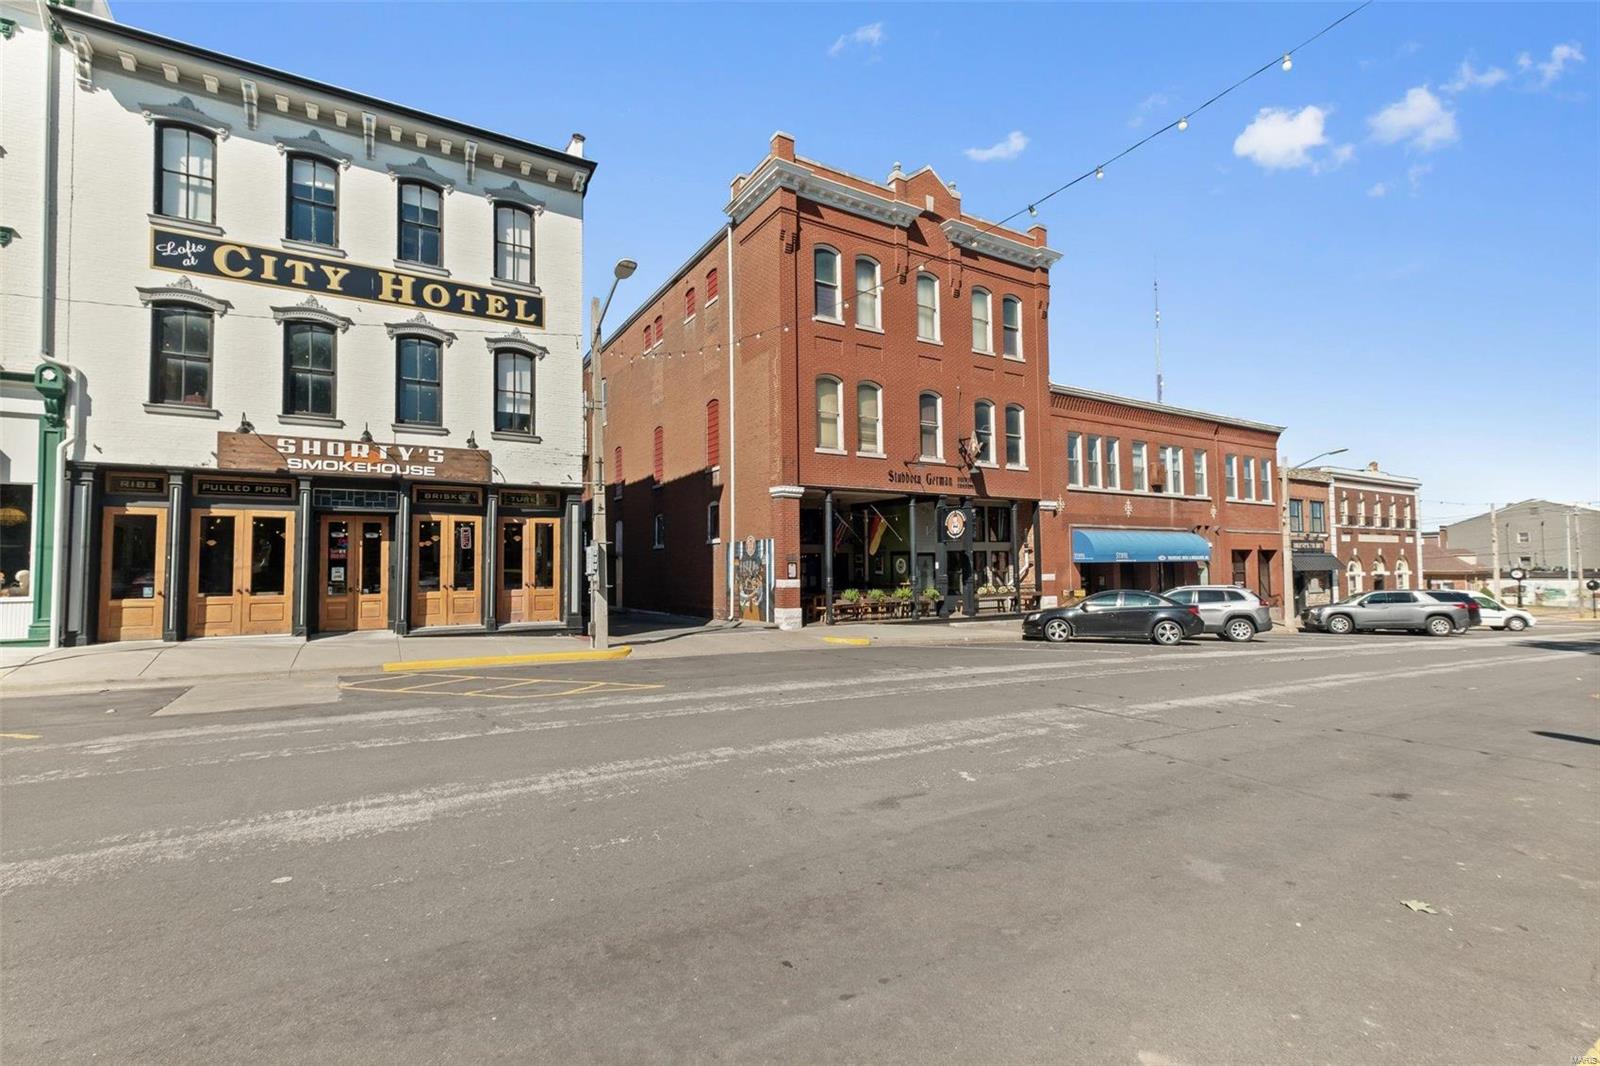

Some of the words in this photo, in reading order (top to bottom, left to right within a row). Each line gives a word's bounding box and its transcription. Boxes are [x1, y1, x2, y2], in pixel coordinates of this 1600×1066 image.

[156, 240, 207, 257] Lofts
[182, 255, 199, 266] at
[213, 245, 350, 291] CITY
[378, 272, 537, 322] HOTEL
[277, 438, 444, 463] SHORTY'S
[287, 458, 436, 477] SMOKEHOUSE
[119, 480, 157, 488] RIBS
[888, 470, 921, 484] Stubborn
[926, 473, 953, 487] German
[202, 483, 250, 492] PULLED
[254, 486, 288, 494] PORK
